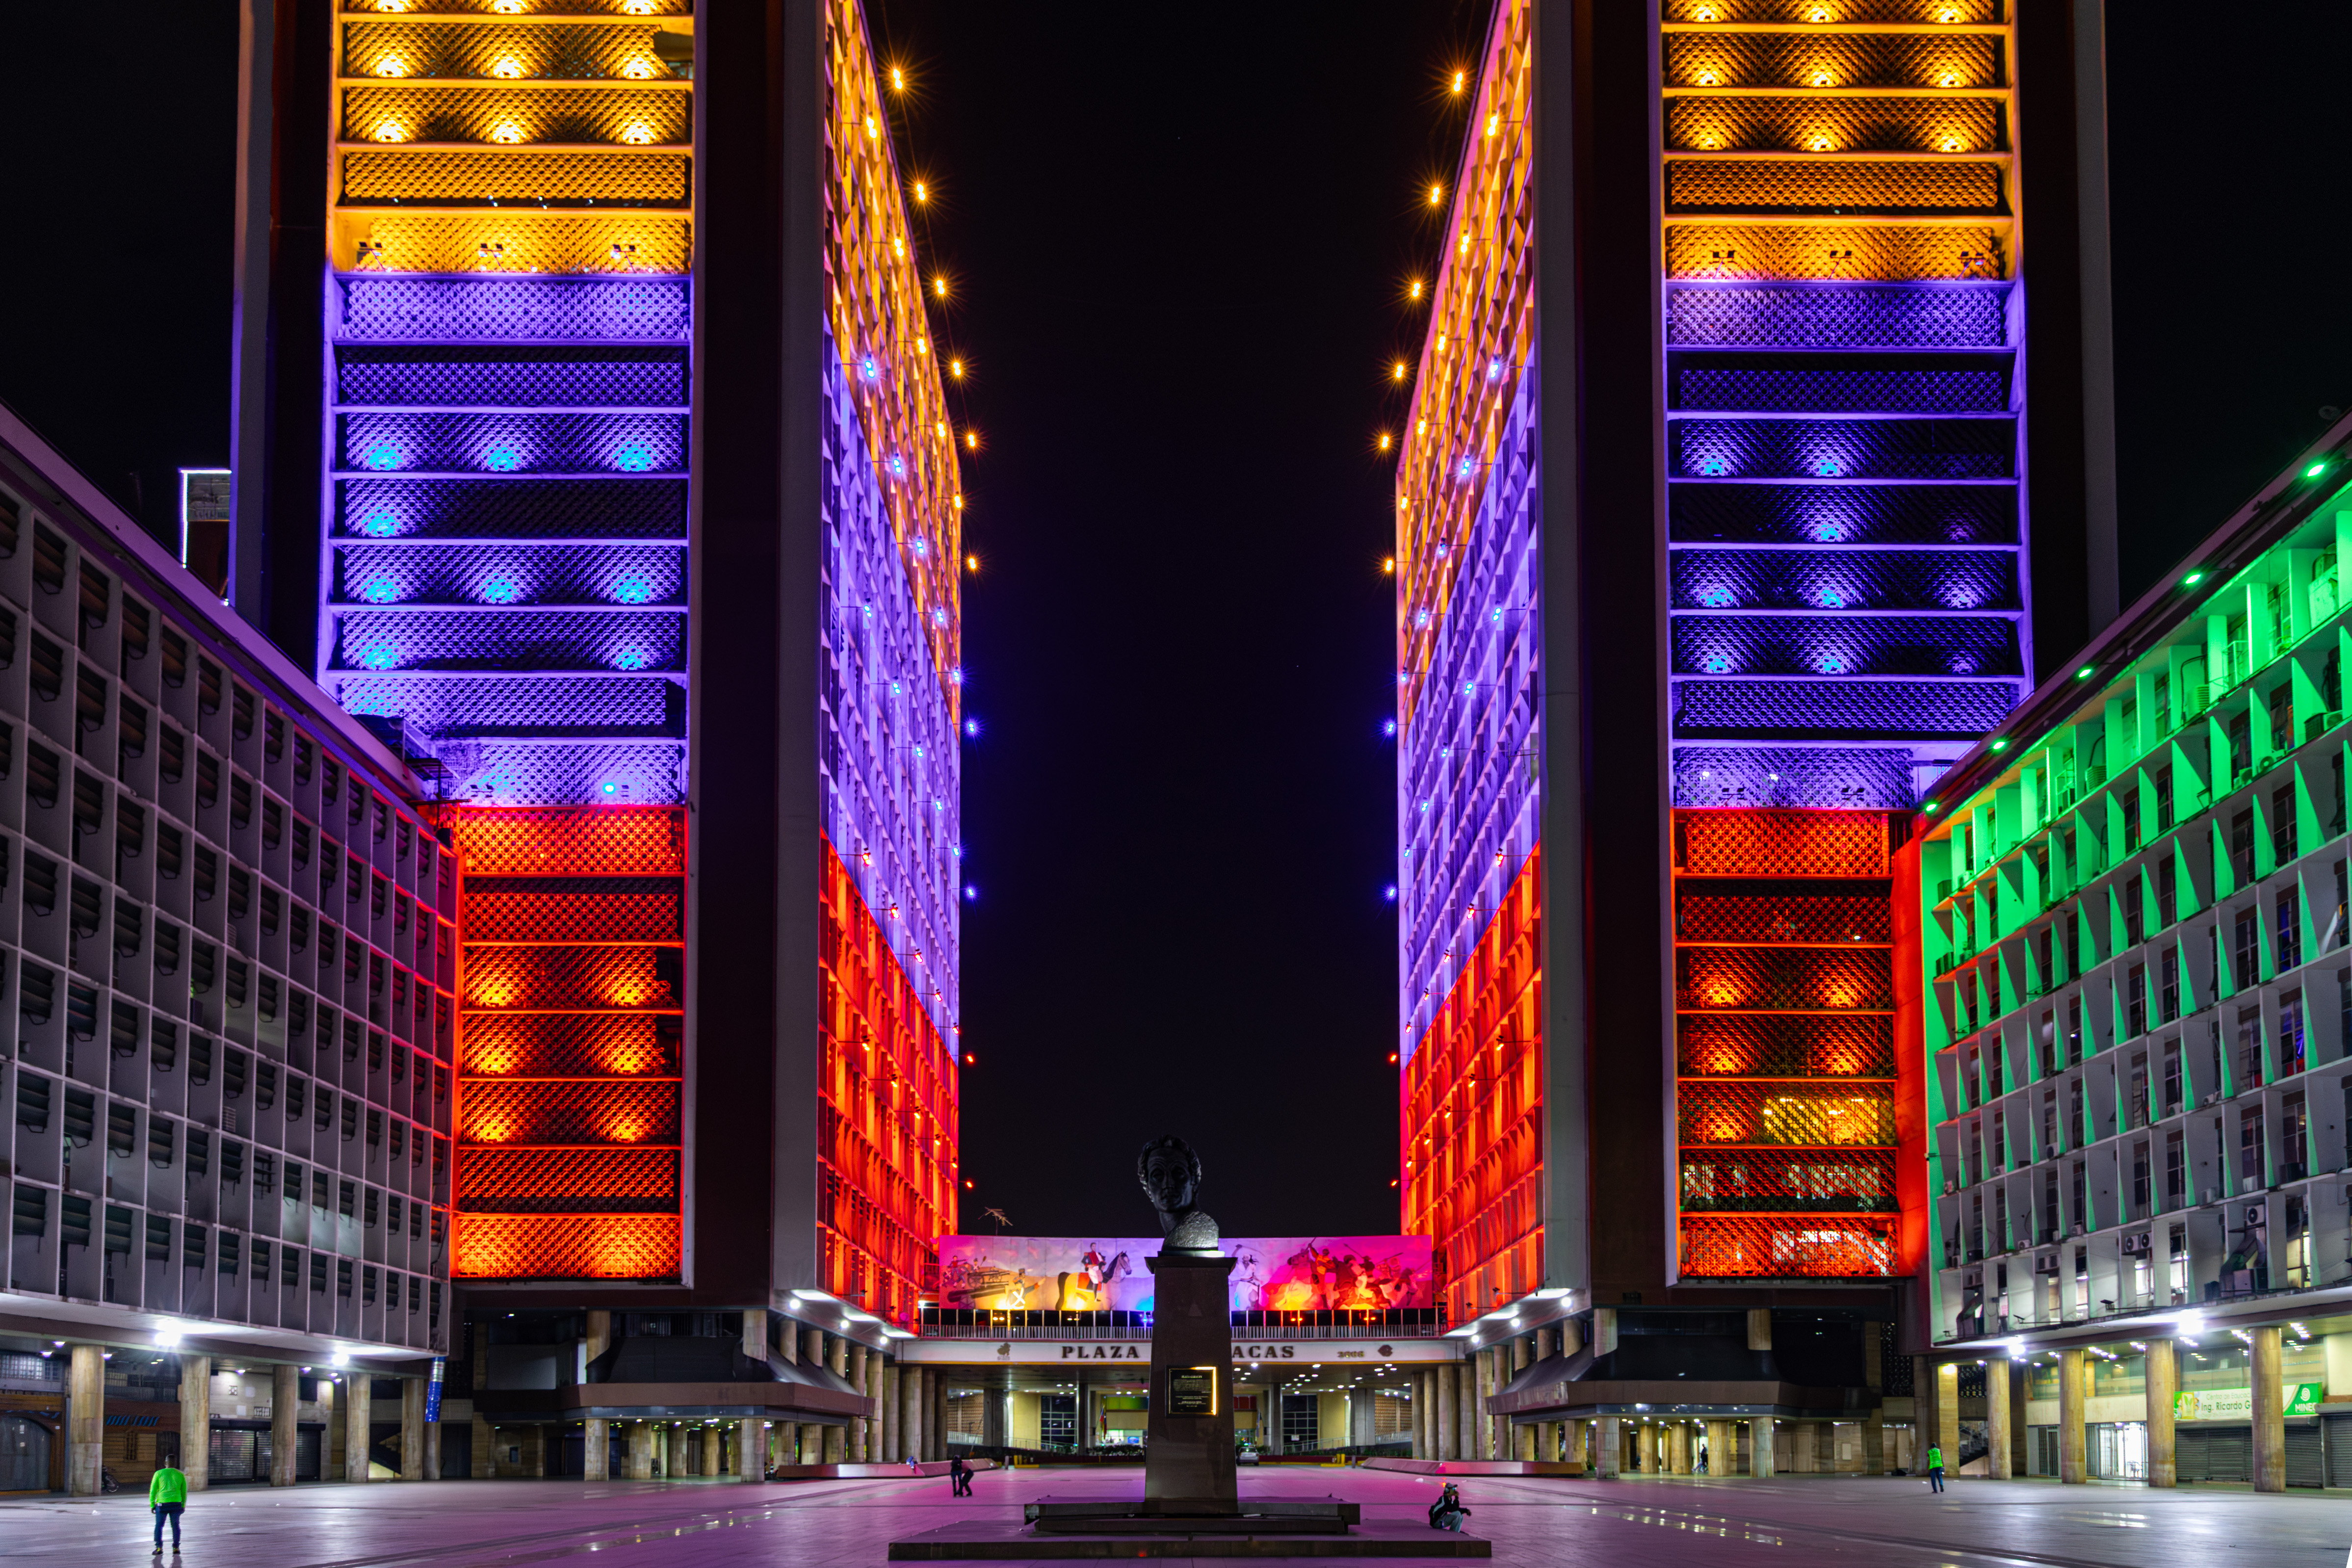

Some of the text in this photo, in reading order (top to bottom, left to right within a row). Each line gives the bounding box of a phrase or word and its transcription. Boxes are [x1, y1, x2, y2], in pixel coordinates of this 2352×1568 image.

[1061, 1346, 1139, 1359] PLAZA
[2201, 1402, 2214, 1412] Ing.
[2216, 1401, 2242, 1411] Ricardo
